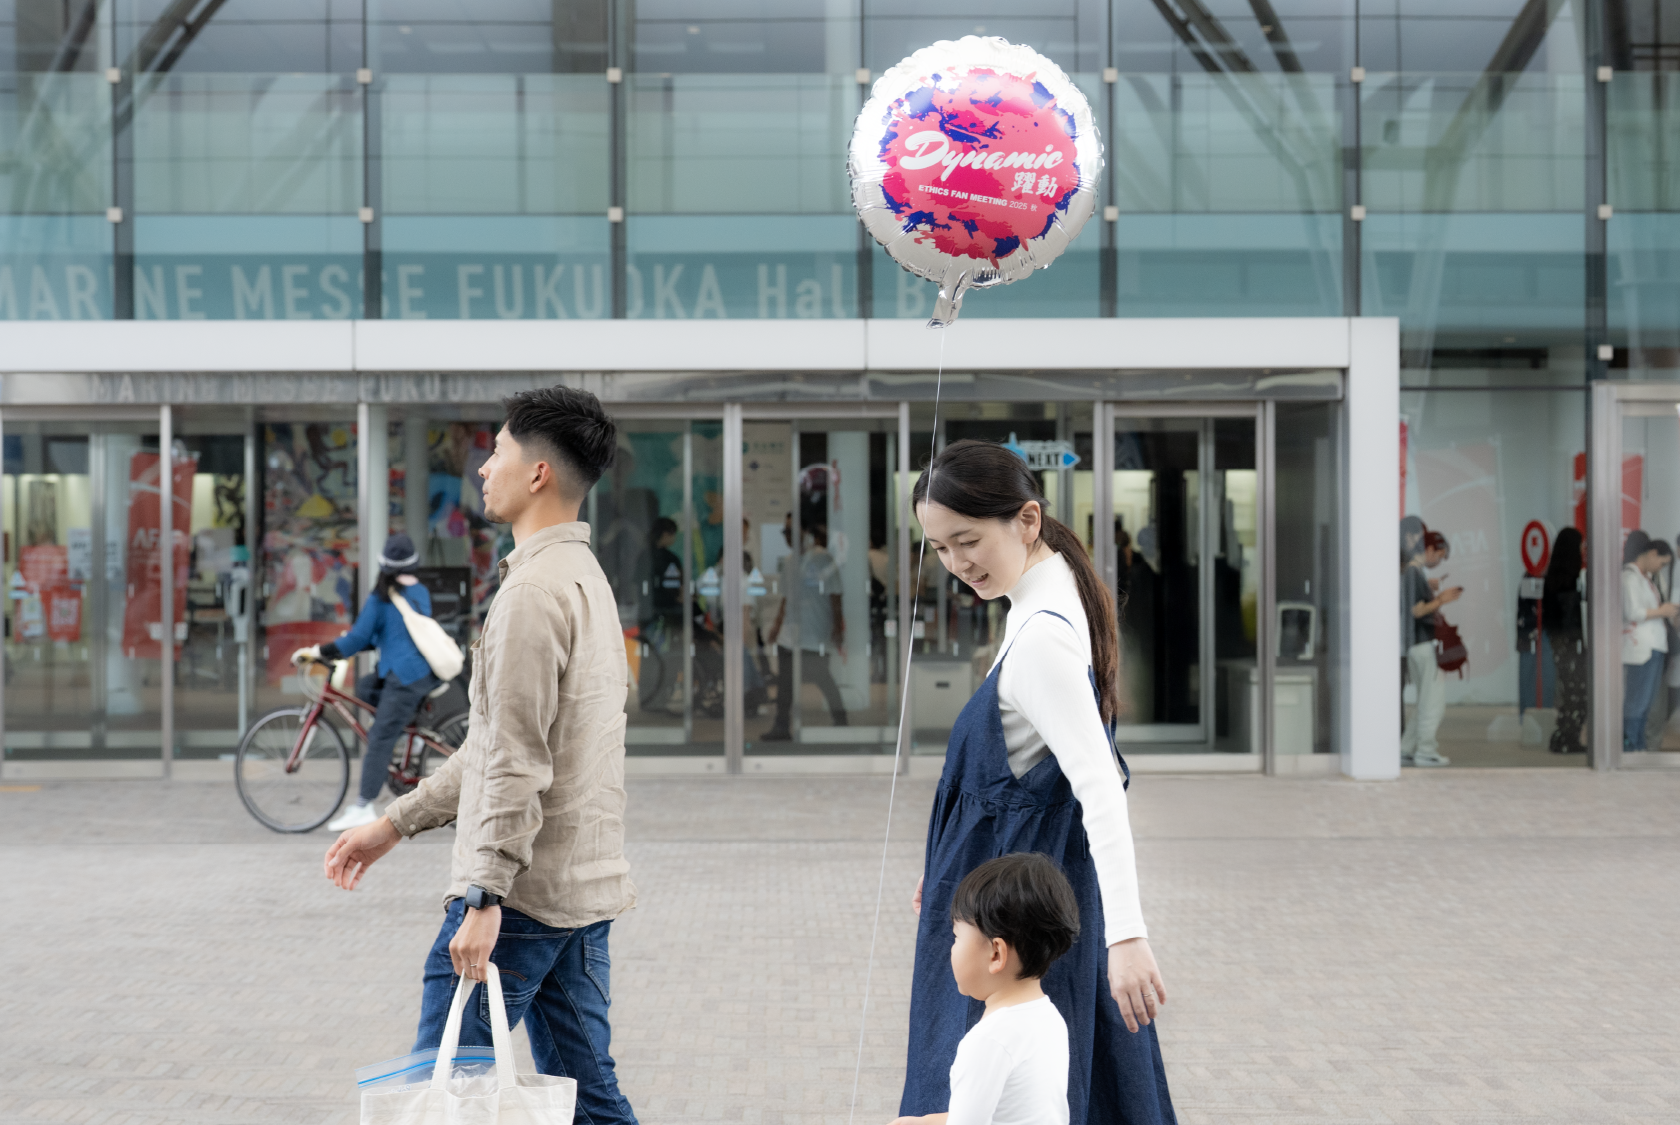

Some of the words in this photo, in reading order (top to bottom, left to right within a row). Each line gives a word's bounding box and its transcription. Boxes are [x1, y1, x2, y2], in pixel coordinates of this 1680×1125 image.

[900, 131, 1064, 181] Dynamic
[918, 184, 949, 196] ETHICS
[951, 190, 969, 200] FAN
[969, 193, 1008, 207] MEETING
[1009, 200, 1028, 210] 2025
[1010, 171, 1059, 198] 躍動
[1027, 452, 1061, 466] NEXT
